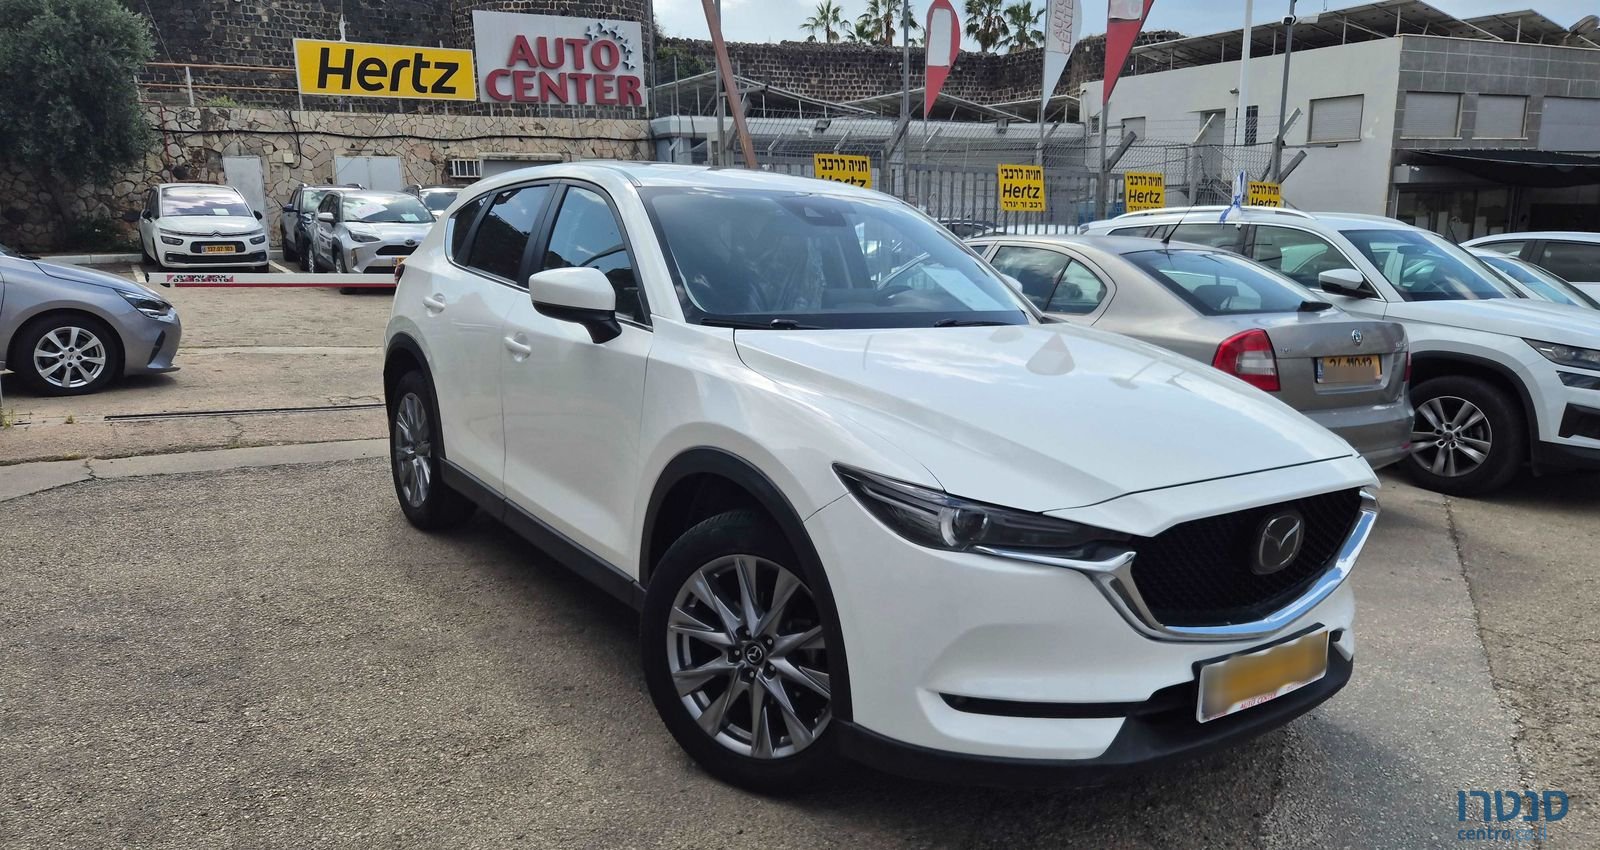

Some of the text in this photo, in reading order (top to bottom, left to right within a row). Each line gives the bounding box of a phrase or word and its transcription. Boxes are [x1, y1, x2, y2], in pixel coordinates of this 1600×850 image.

[1062, 0, 1073, 55] CENTE
[506, 34, 620, 72] AUTO
[317, 47, 459, 94] Hertz
[485, 68, 643, 107] CENTER
[817, 157, 868, 173] חניה לרכבי
[1000, 168, 1041, 181] חניה לרכבי
[1127, 175, 1162, 187] חניה לרכבי
[1002, 183, 1041, 199] Hertz
[1128, 189, 1161, 204] Hertz
[1251, 197, 1278, 208] Hertz
